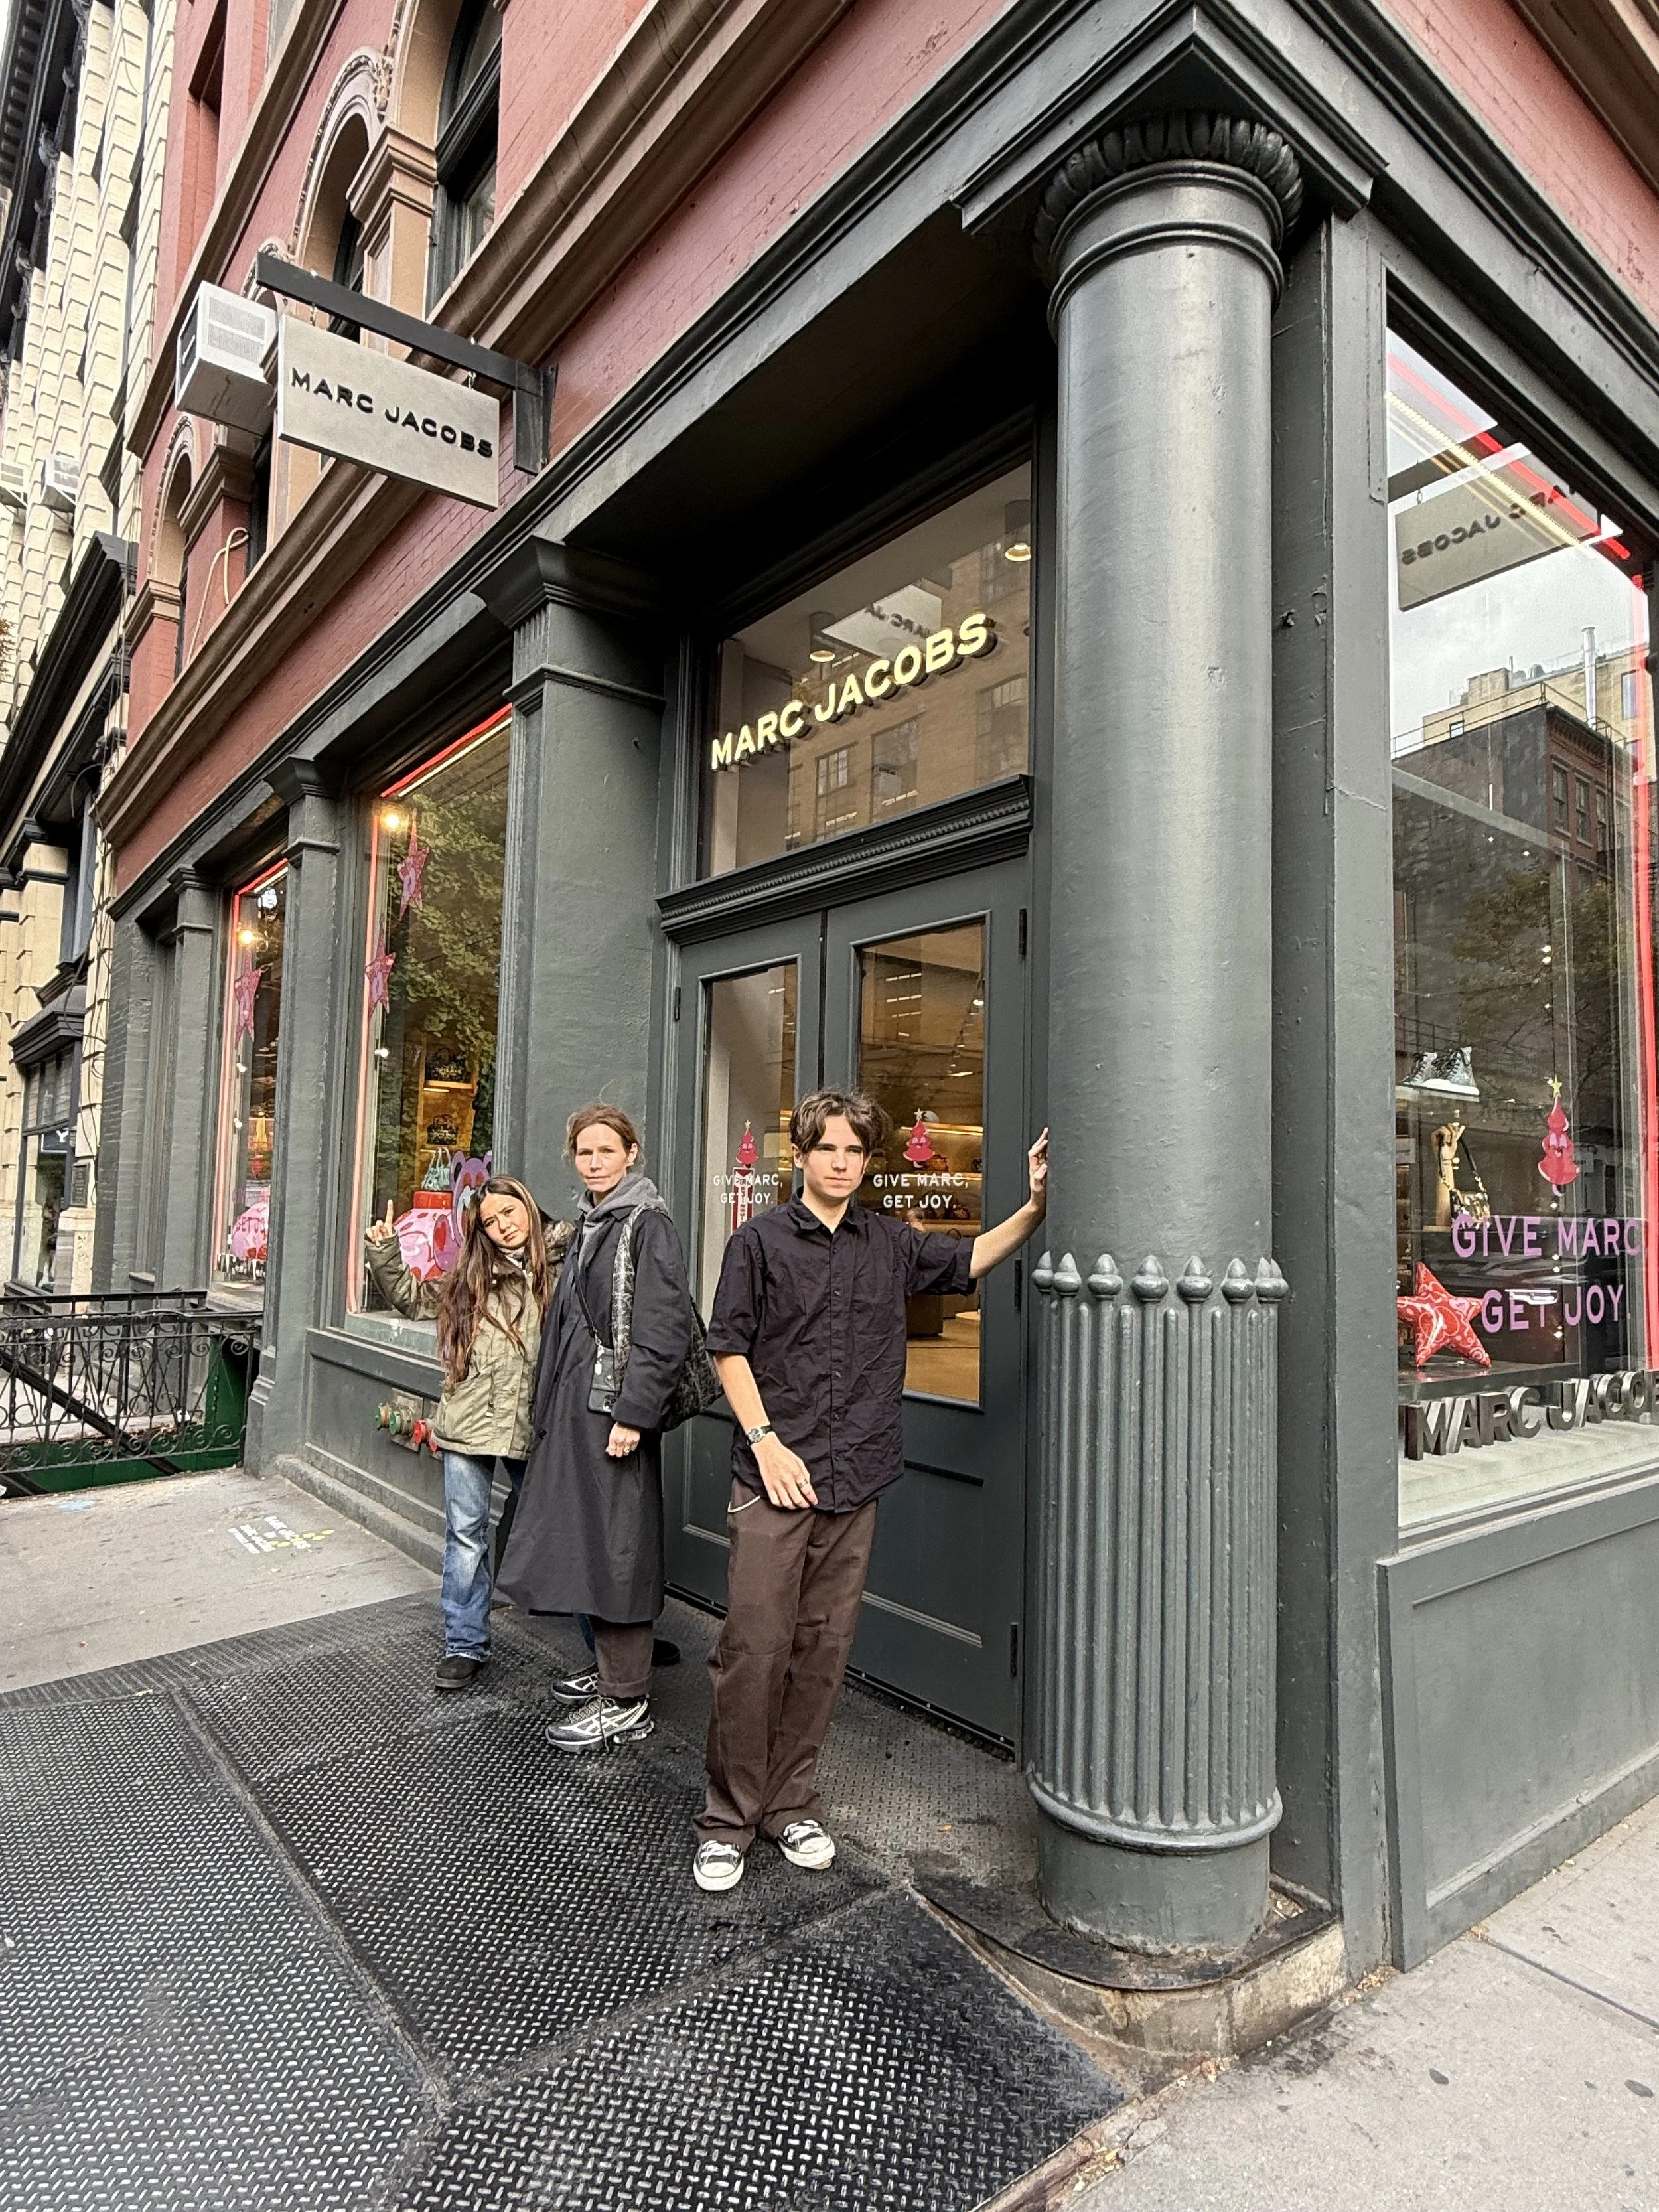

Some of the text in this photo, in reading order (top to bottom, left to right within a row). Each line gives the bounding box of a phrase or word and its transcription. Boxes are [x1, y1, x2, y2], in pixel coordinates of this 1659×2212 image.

[291, 368, 493, 458] MARC JACOBS
[711, 613, 987, 771] MARC JACOBS
[873, 1172, 969, 1189] GIVE MARC,
[883, 1194, 957, 1209] GET JOY.
[1452, 1214, 1542, 1258] GIVE
[1405, 1387, 1542, 1461] MARC
